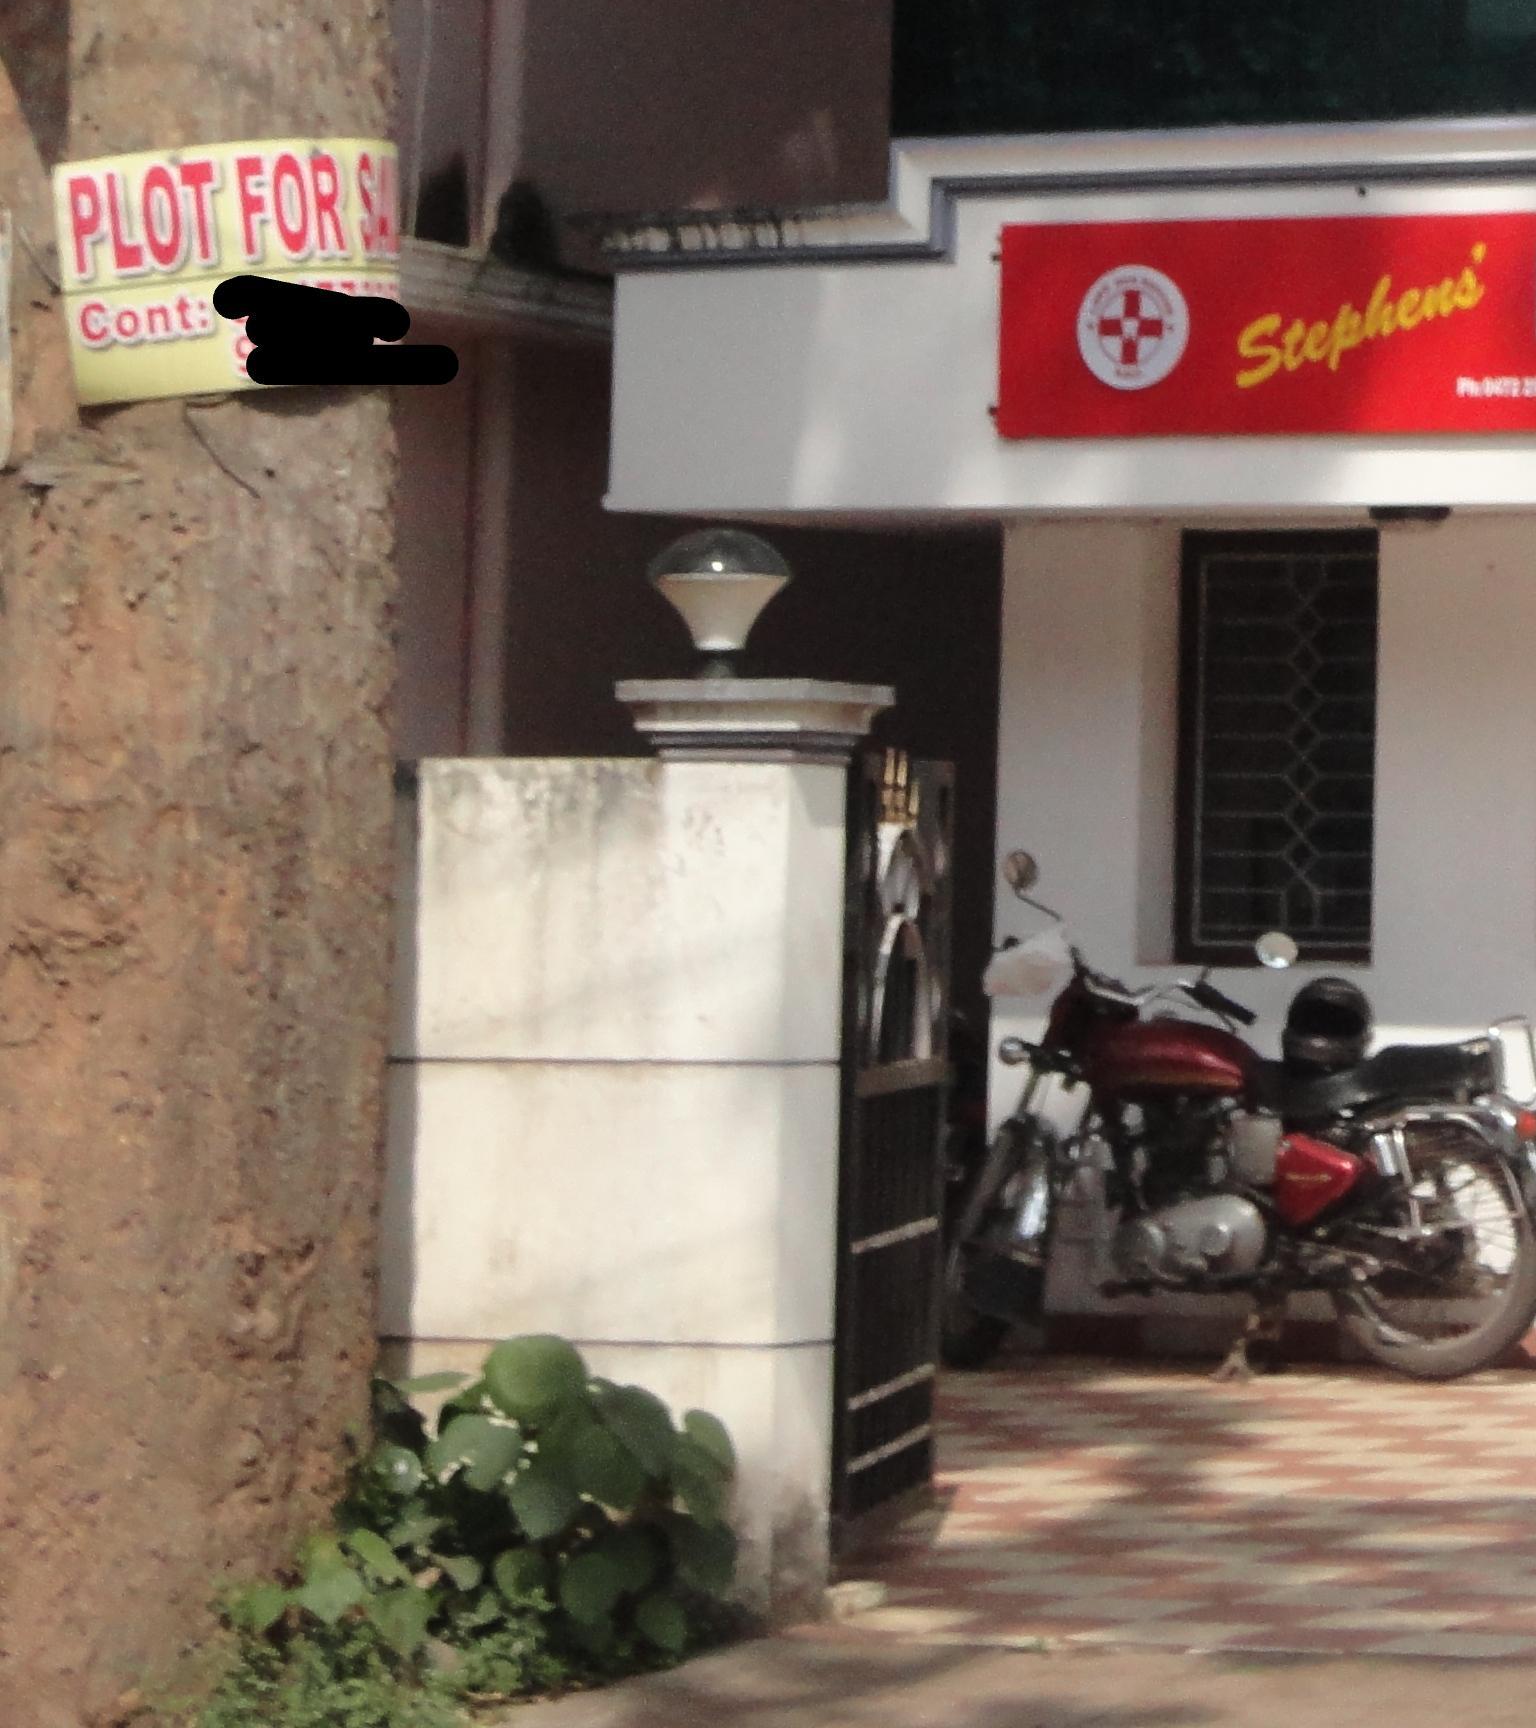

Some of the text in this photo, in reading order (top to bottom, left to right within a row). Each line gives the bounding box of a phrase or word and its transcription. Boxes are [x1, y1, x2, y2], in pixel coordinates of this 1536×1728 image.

[68, 160, 215, 275] PLOT
[235, 152, 347, 256] FOR
[79, 295, 209, 342] Cont:
